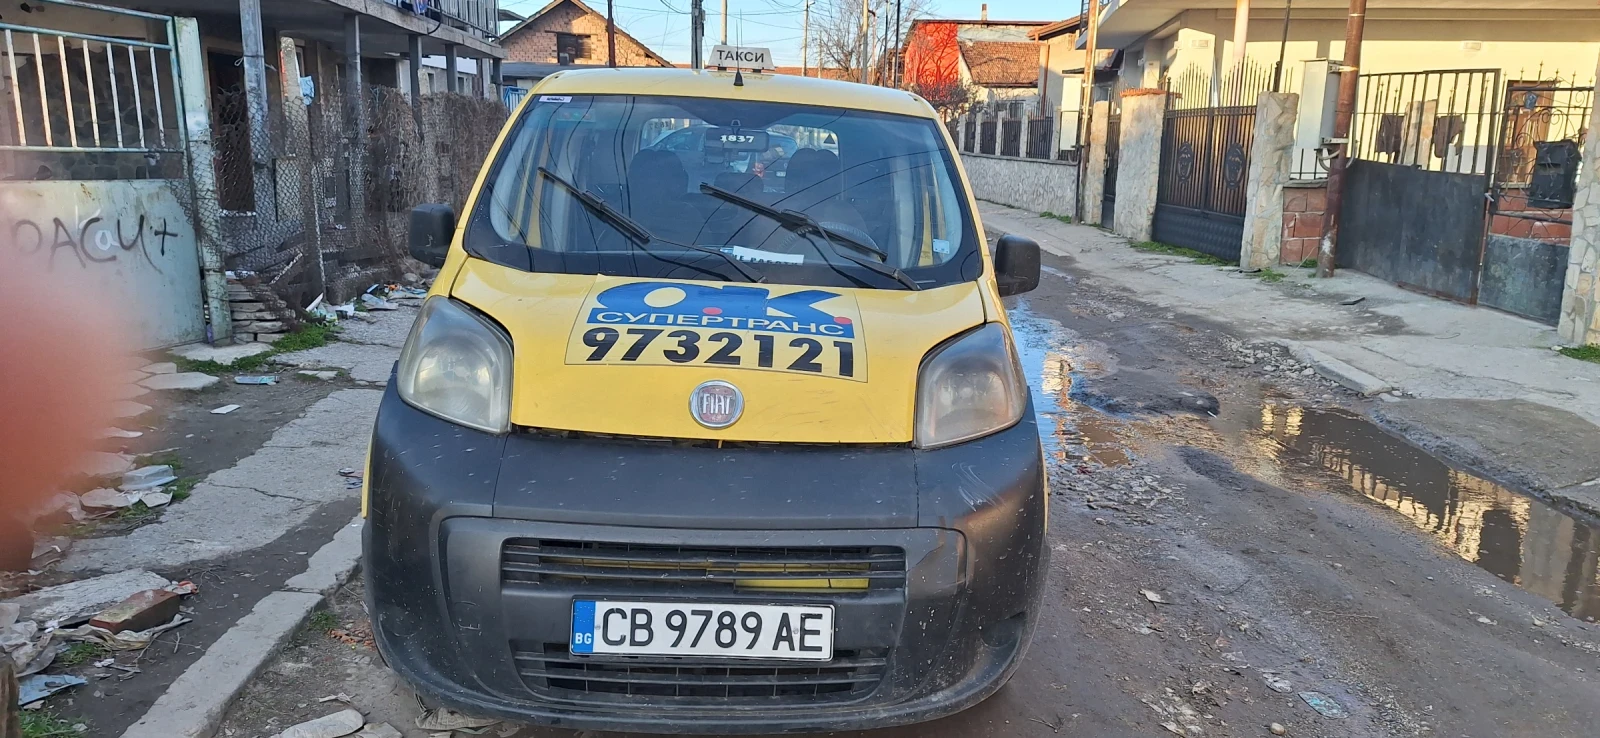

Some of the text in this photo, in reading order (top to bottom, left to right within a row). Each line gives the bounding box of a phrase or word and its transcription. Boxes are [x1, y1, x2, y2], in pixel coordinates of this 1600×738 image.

[716, 49, 764, 63] ТАКСИ
[720, 134, 755, 143] 1837
[596, 311, 844, 335] СУПЕРТРАНС
[582, 326, 854, 378] 9732121
[702, 393, 733, 415] FIAT
[574, 632, 592, 645] BG
[602, 607, 823, 652] CB 9789 AE
